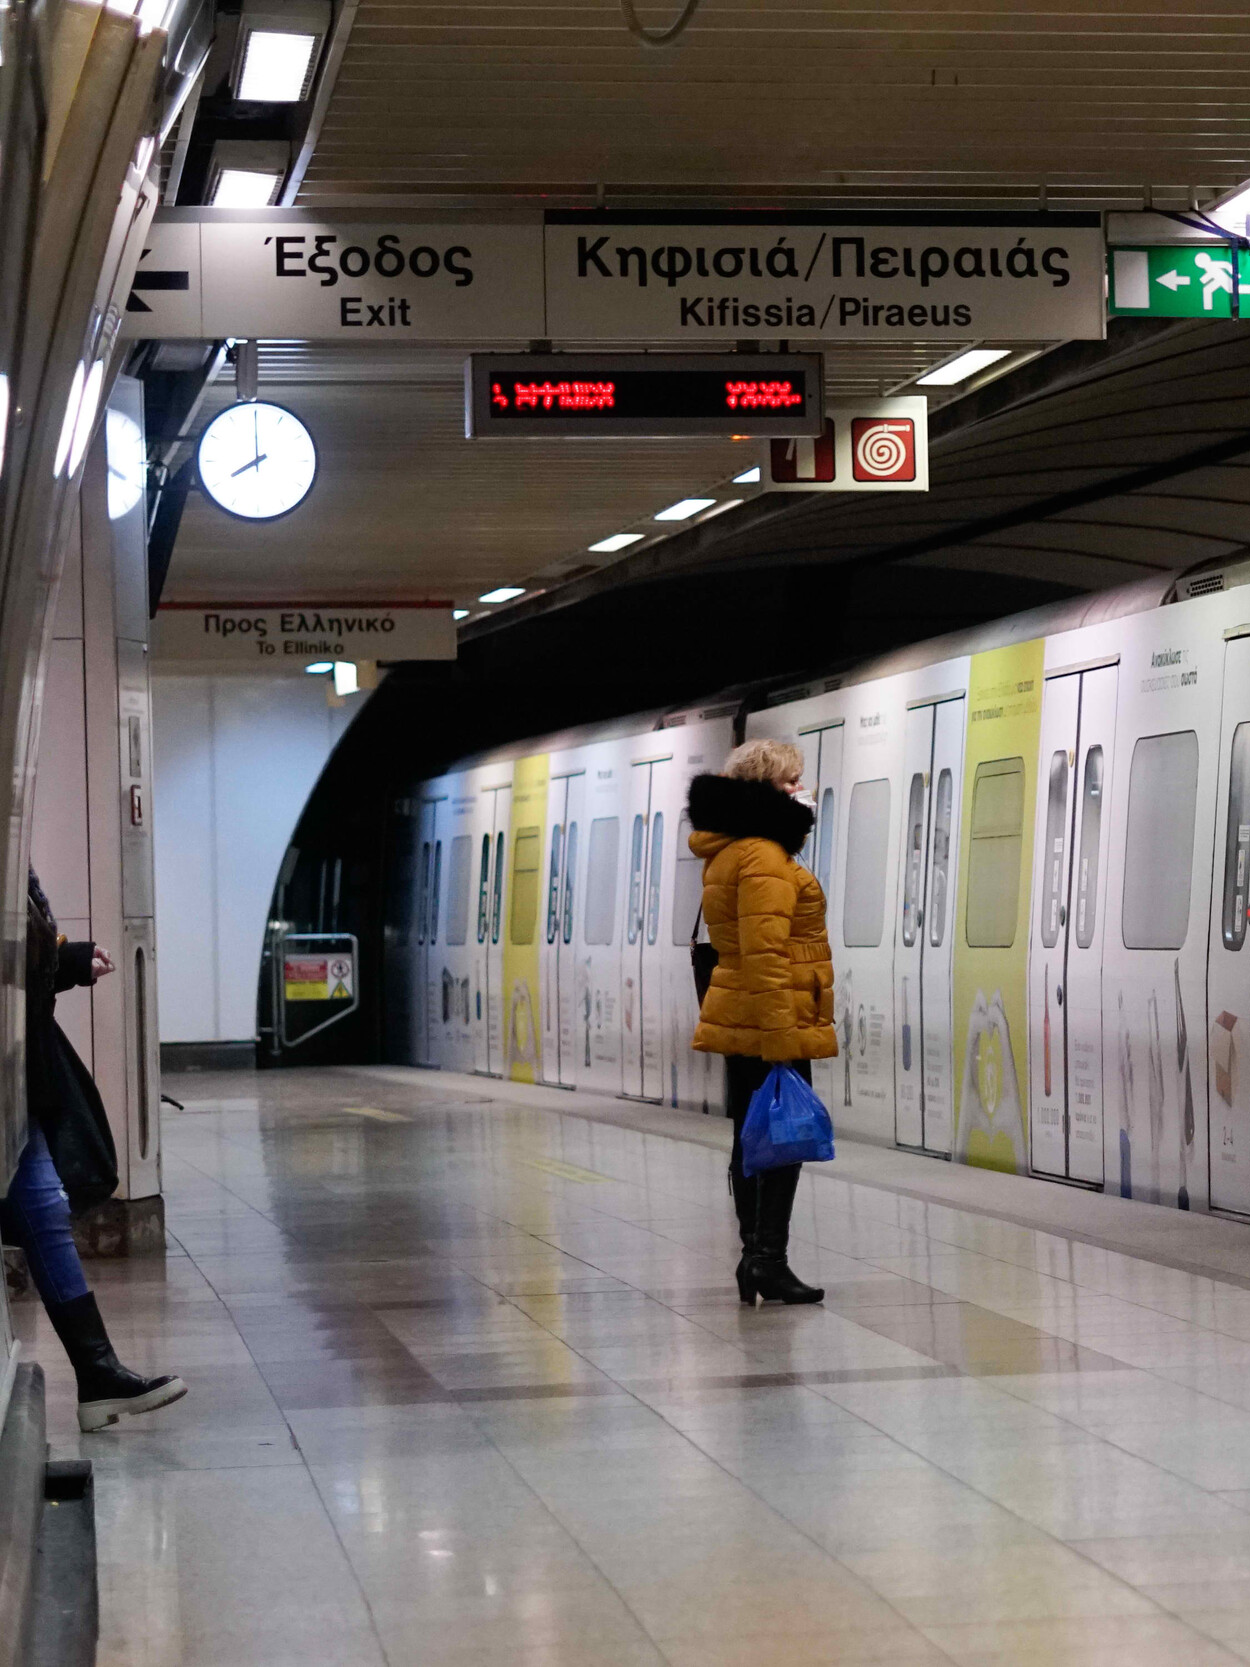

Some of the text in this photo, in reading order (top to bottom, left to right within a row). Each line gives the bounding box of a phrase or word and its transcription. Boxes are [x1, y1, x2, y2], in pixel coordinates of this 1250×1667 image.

[263, 234, 474, 287] Έξοδος
[577, 232, 1071, 288] Κηφισιά/Πειραιάς
[340, 297, 411, 327] Exit
[680, 294, 973, 330] Kifissia/Piraeus
[203, 611, 396, 637] Προς Ελληνικό
[256, 639, 345, 656] To Elliniko
